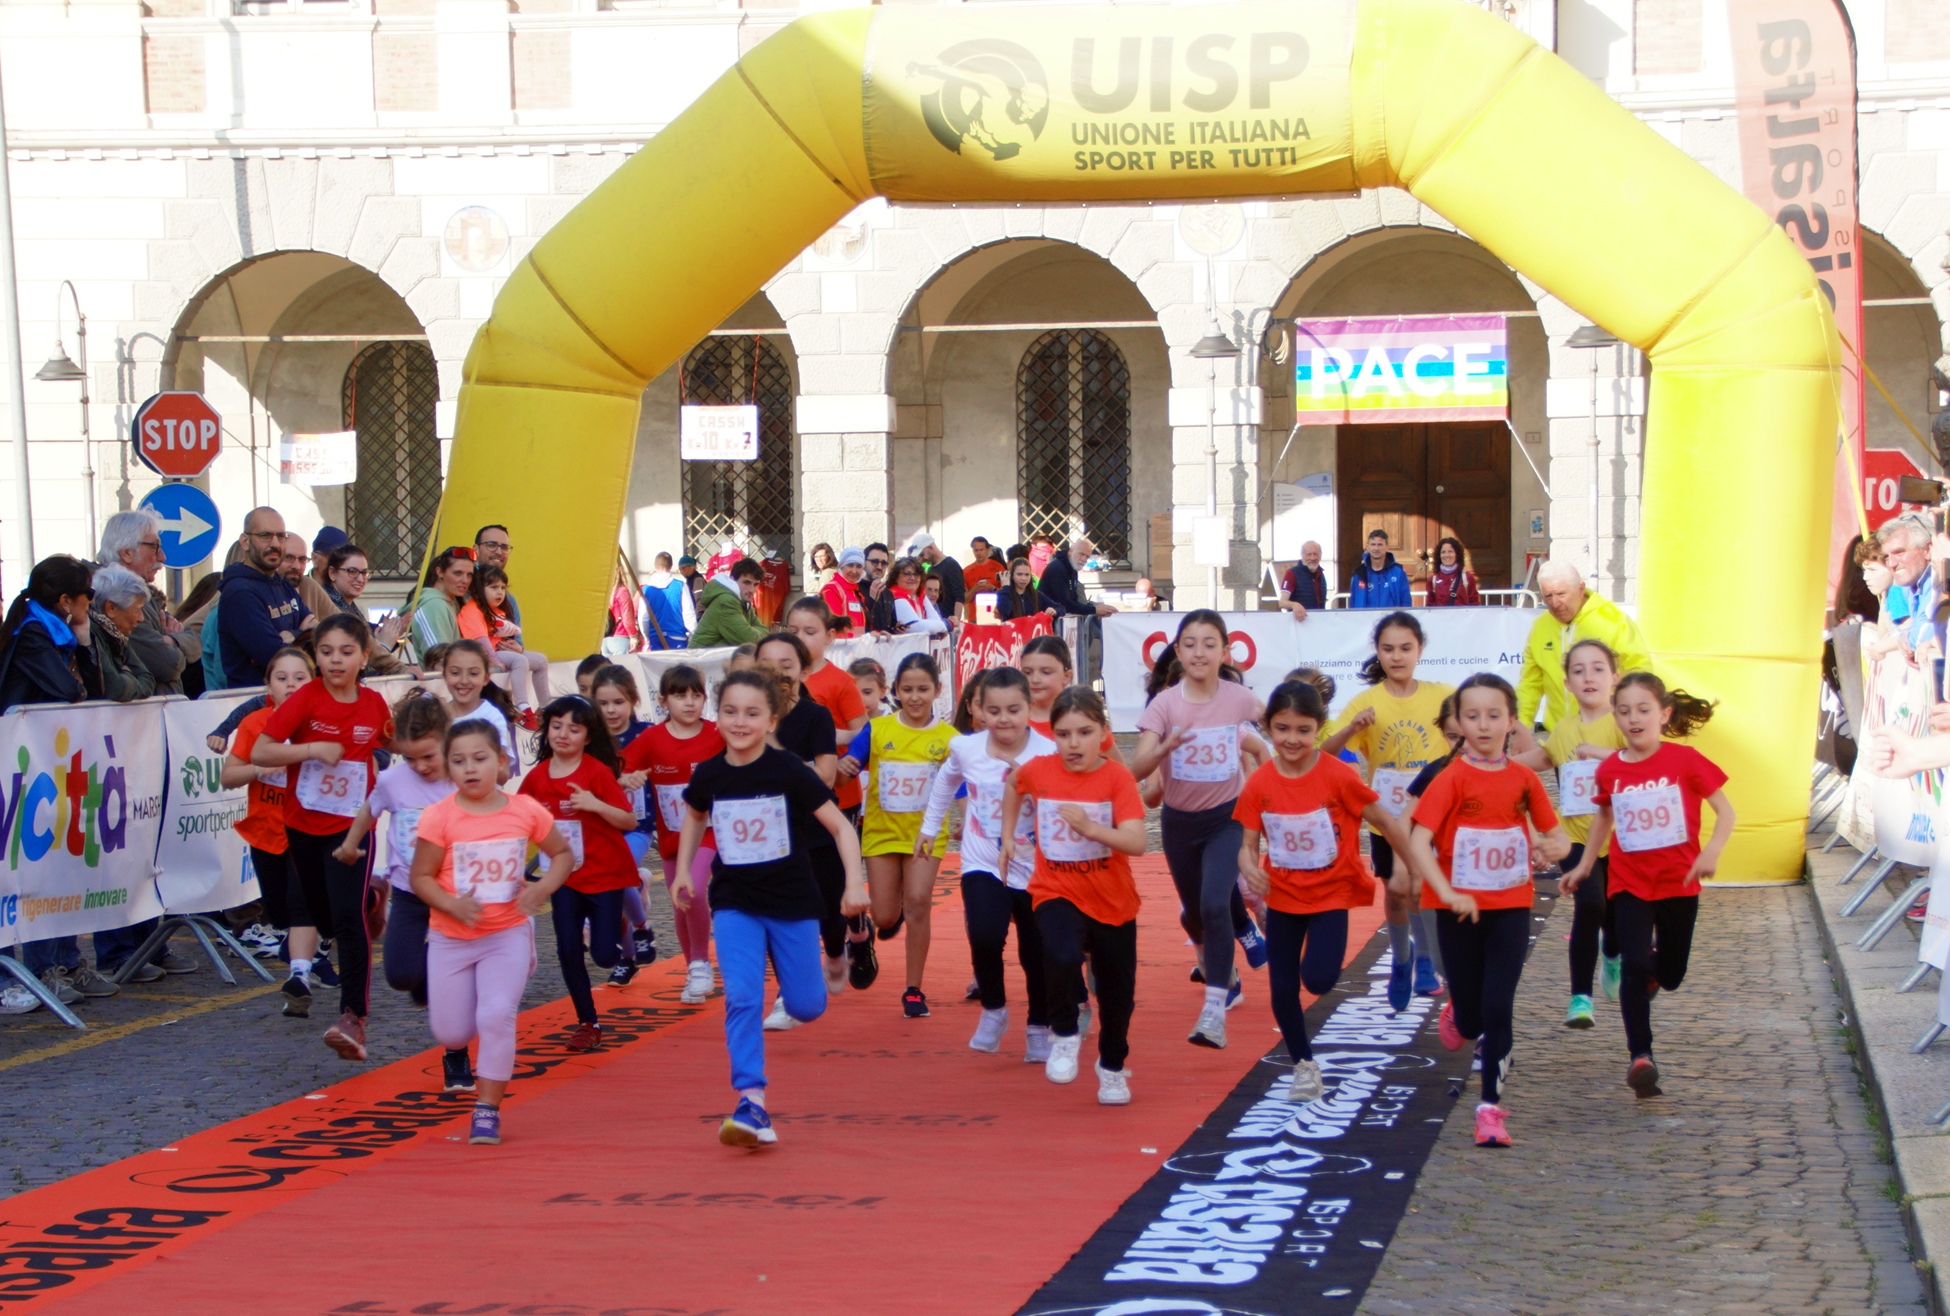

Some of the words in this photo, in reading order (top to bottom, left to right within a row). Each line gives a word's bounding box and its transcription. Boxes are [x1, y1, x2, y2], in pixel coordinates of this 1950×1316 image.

[1070, 31, 1310, 114] UISP
[1071, 122, 1176, 146] UNIONE
[1189, 117, 1311, 145] ITALIANA
[1074, 150, 1157, 171] SPORT
[1169, 150, 1216, 170] PER
[1229, 146, 1297, 169] TUTTI
[1311, 343, 1492, 398] PACE
[144, 418, 217, 450] STOP
[1459, 656, 1489, 665] cucine
[1184, 743, 1228, 766] 233
[318, 774, 349, 798] 53
[887, 777, 928, 797] 257
[990, 798, 1036, 820] 23
[1623, 805, 1671, 833] 299
[732, 818, 767, 844] 92
[1283, 830, 1315, 852] 85
[468, 857, 518, 884] 292
[1469, 846, 1517, 871] 108
[21, 894, 82, 922] rigenerare
[84, 888, 127, 910] innovare
